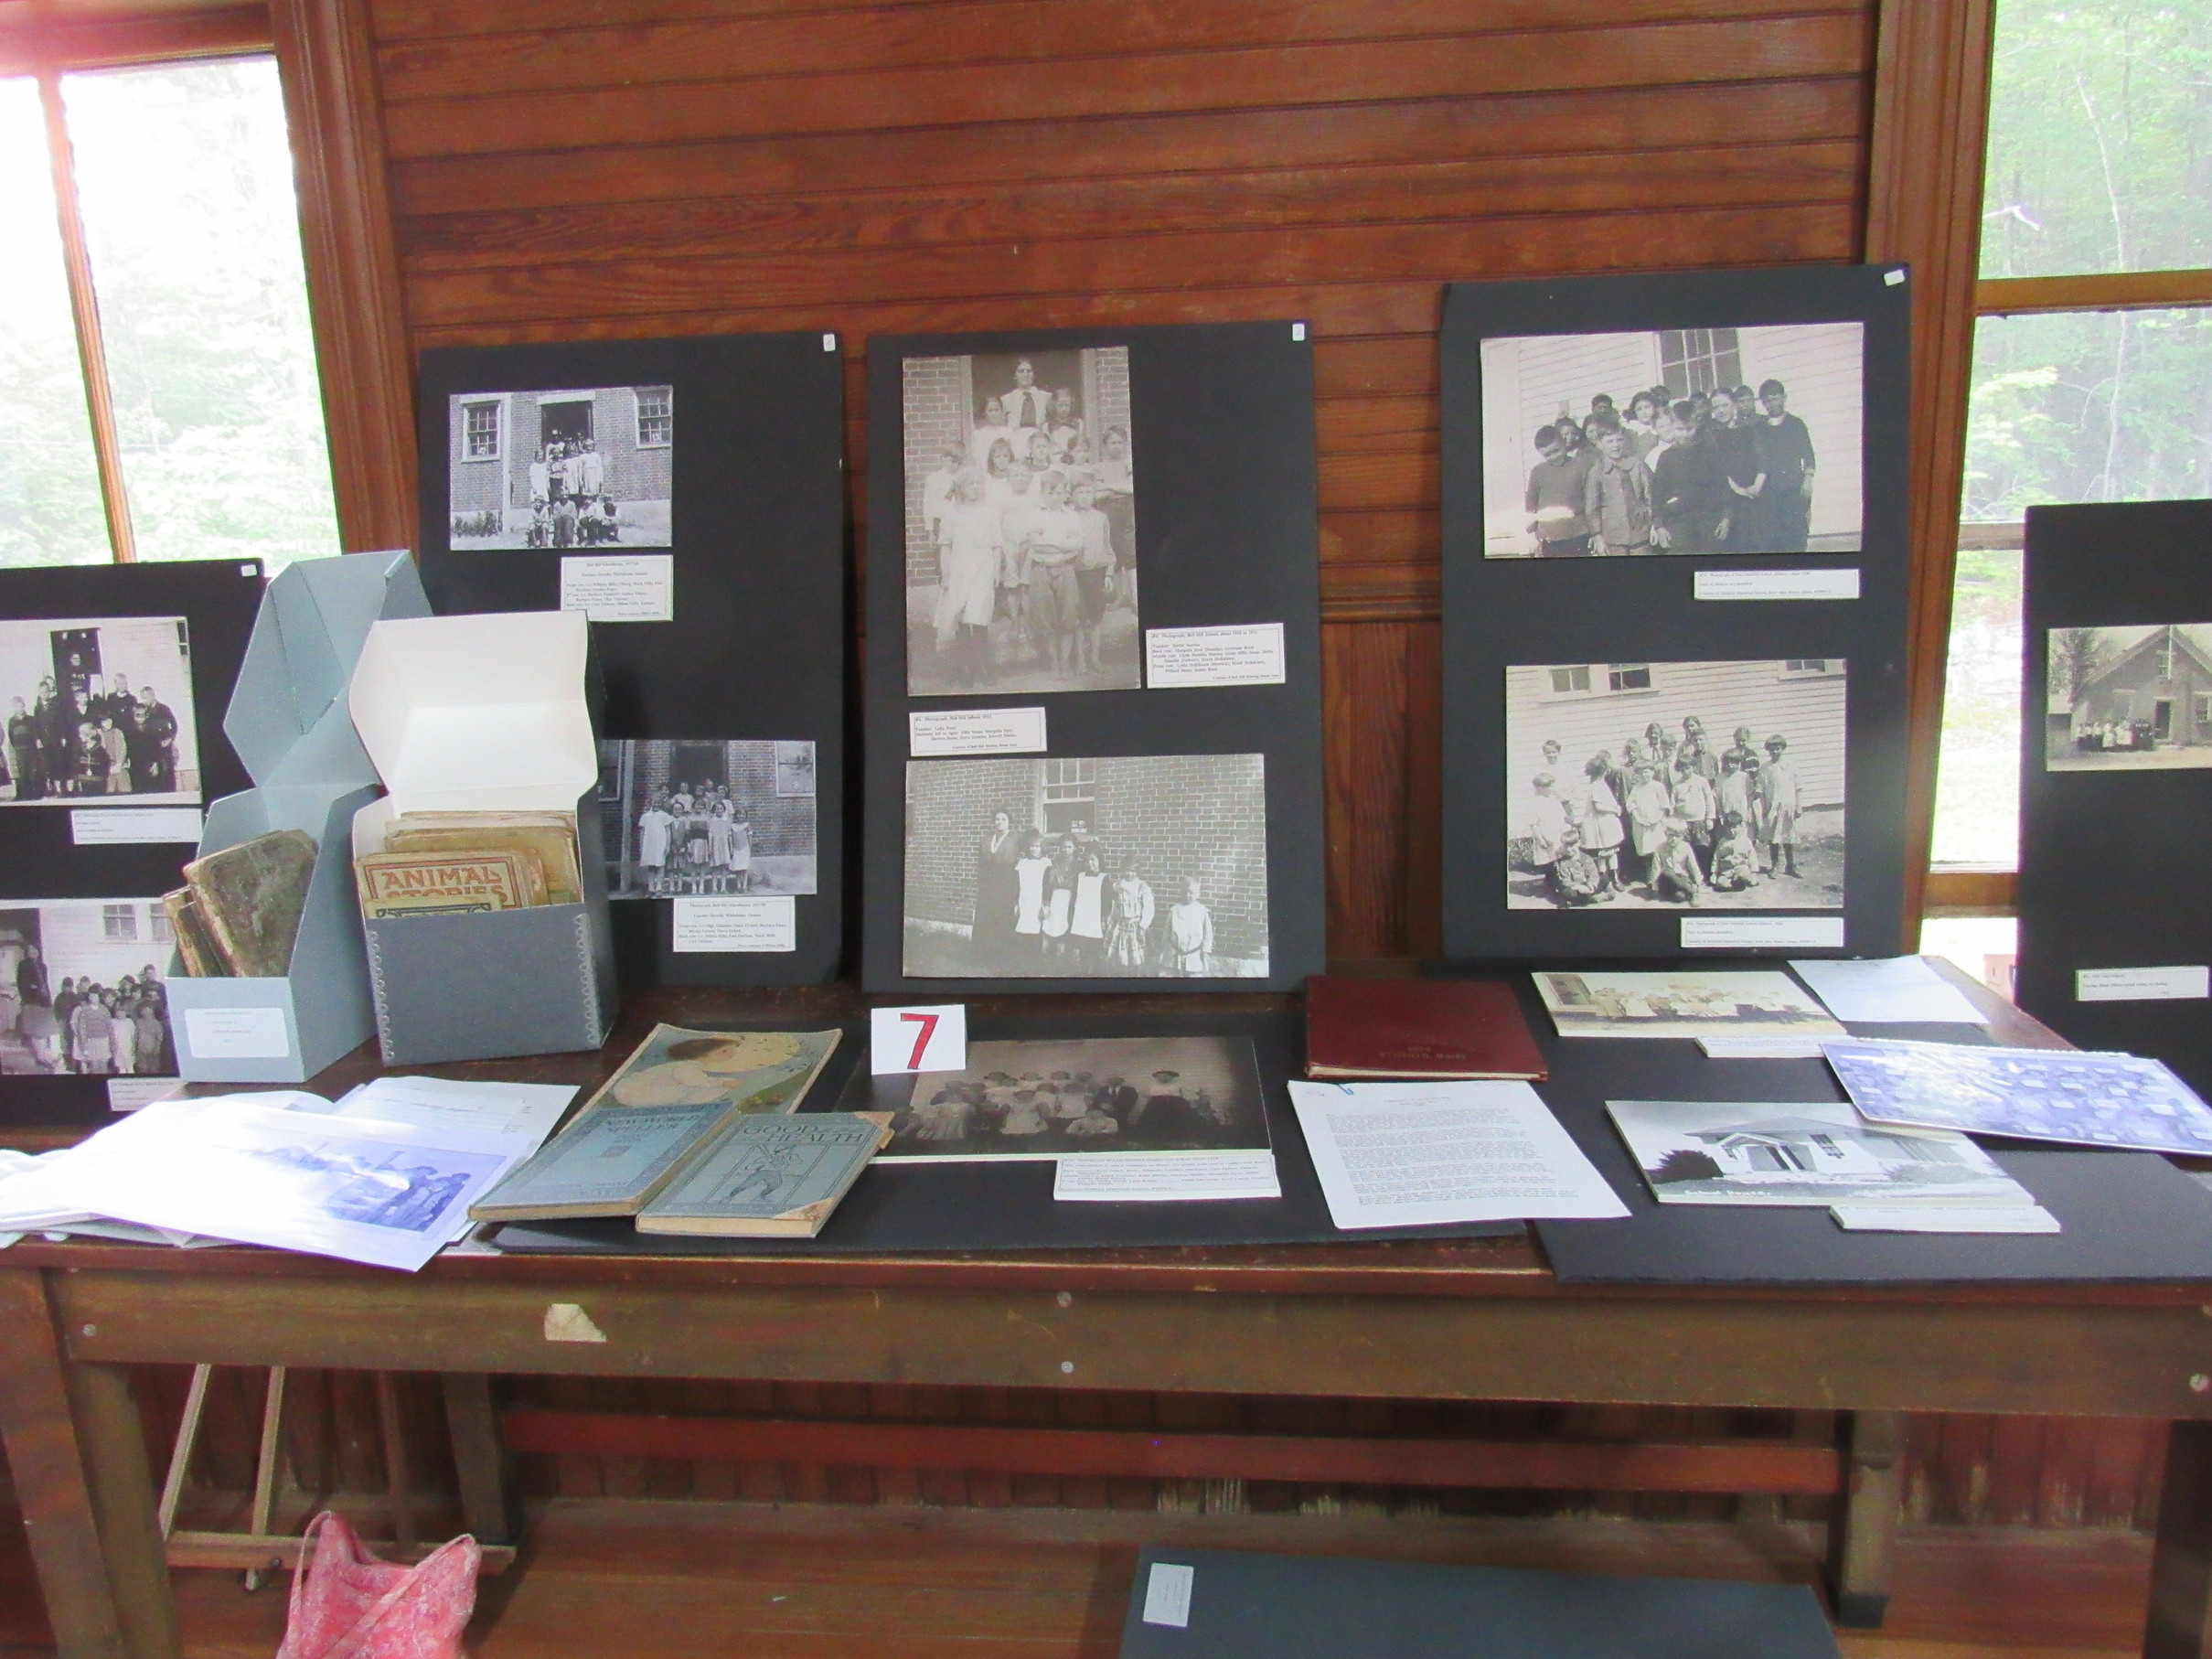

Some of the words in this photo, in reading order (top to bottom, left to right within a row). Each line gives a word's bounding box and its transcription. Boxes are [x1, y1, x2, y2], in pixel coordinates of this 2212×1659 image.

[381, 866, 502, 889] ANIMAL
[901, 1013, 939, 1069] 7
[743, 1125, 818, 1134] GOOD
[766, 1133, 863, 1142] HEALTH
